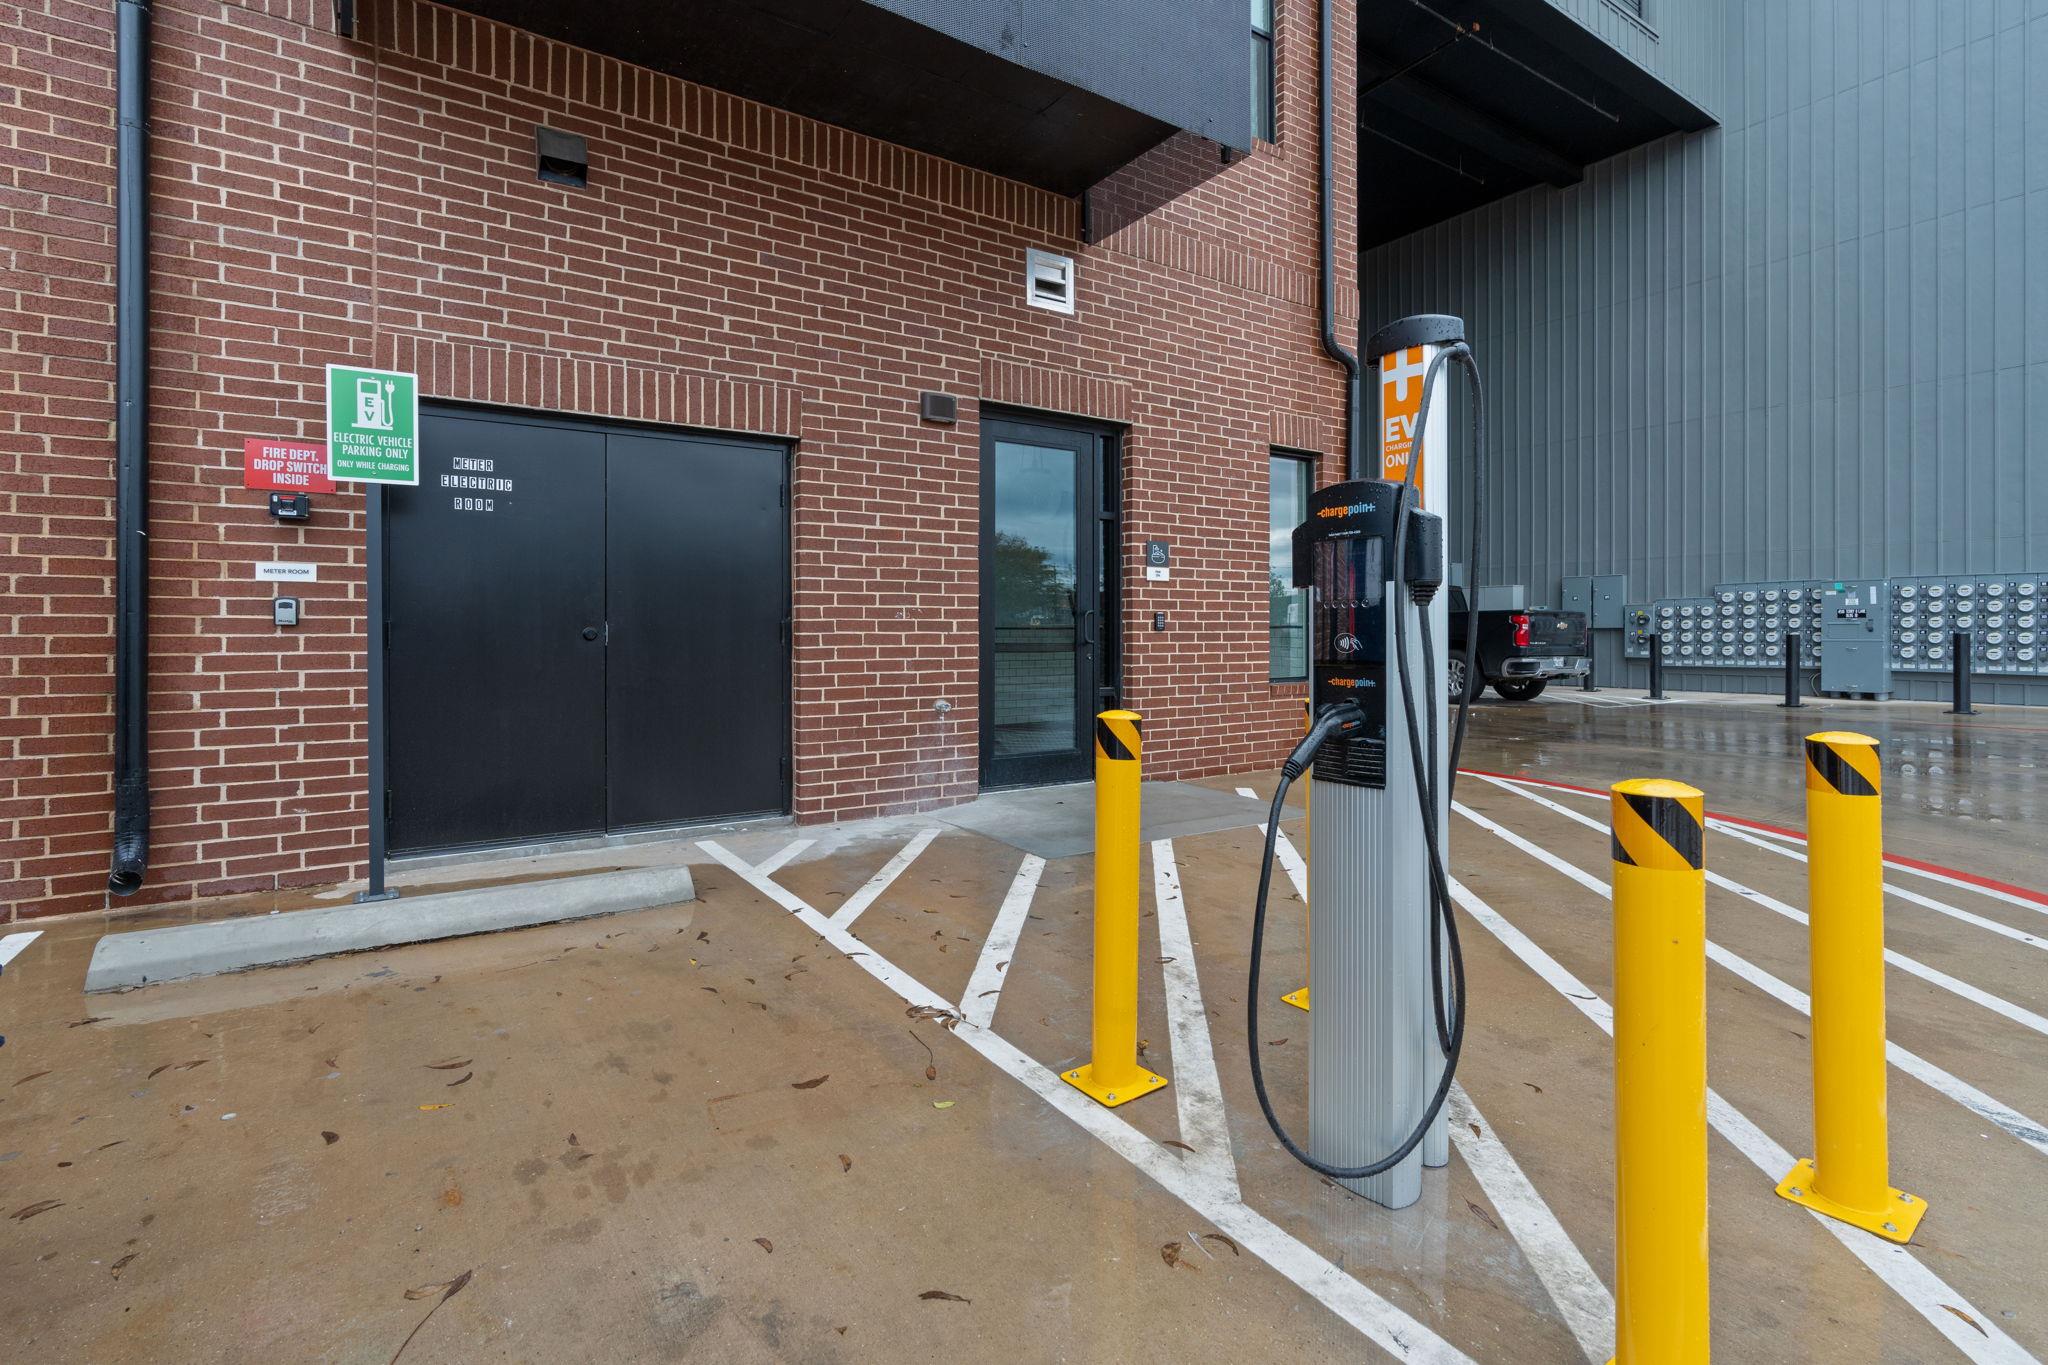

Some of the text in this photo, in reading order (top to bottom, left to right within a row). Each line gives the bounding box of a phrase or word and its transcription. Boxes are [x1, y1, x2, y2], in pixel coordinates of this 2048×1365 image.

[1386, 412, 1420, 442] EV
[333, 432, 413, 448] ELECTRIC VEHICLE
[1385, 441, 1413, 452] CHARGI
[262, 446, 319, 462] FIRE DEPT.
[342, 445, 409, 459] PARKING ONLY
[253, 458, 328, 475] DROP SWITCH
[337, 460, 410, 472] ONLY WHILE CHARGING
[453, 457, 493, 471] METER
[272, 473, 310, 486] INSIDE
[441, 475, 512, 491] ELECTRIC
[454, 498, 493, 511] ROOM
